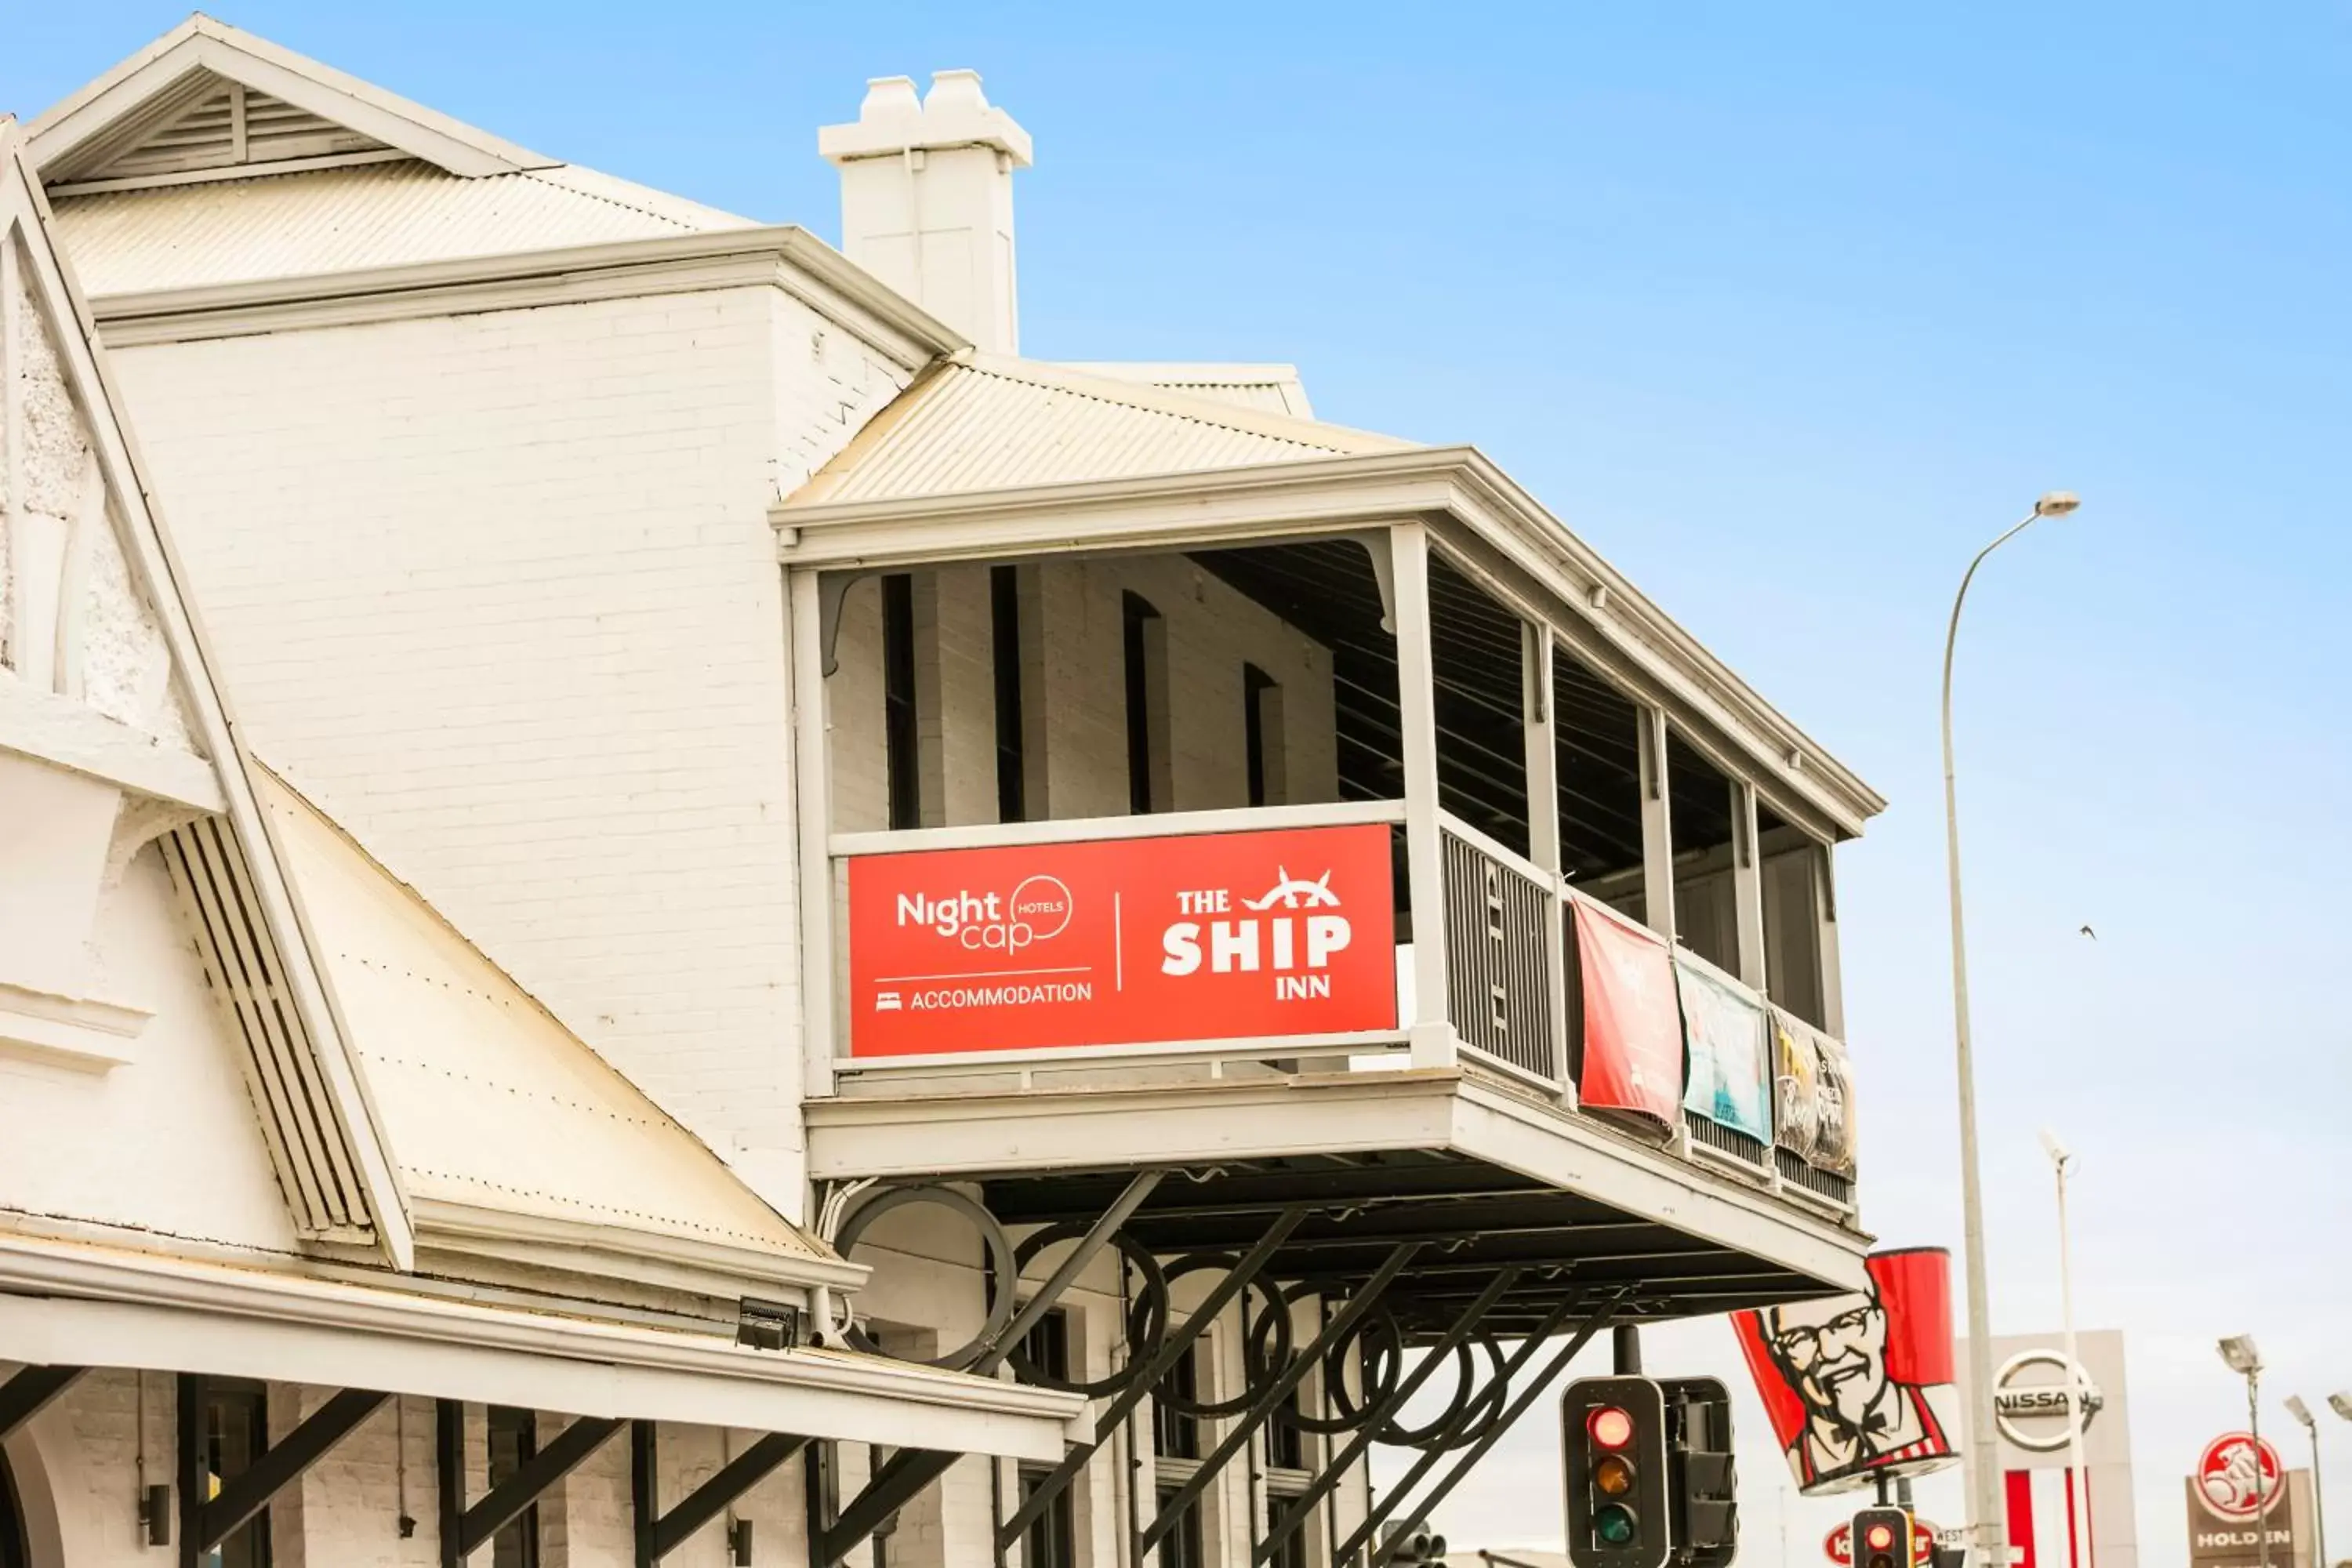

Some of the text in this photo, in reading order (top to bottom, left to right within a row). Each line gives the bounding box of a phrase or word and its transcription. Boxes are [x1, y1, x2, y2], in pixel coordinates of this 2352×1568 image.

[898, 890, 1002, 937] Night
[1018, 902, 1065, 913] HOTELS
[1177, 890, 1231, 914] THE
[960, 923, 1034, 956] cap
[1161, 916, 1352, 976] SHIP
[910, 982, 1092, 1011] ACCOMMODATION
[1276, 975, 1330, 1000] INN
[2197, 1530, 2291, 1548] HOLDEN
